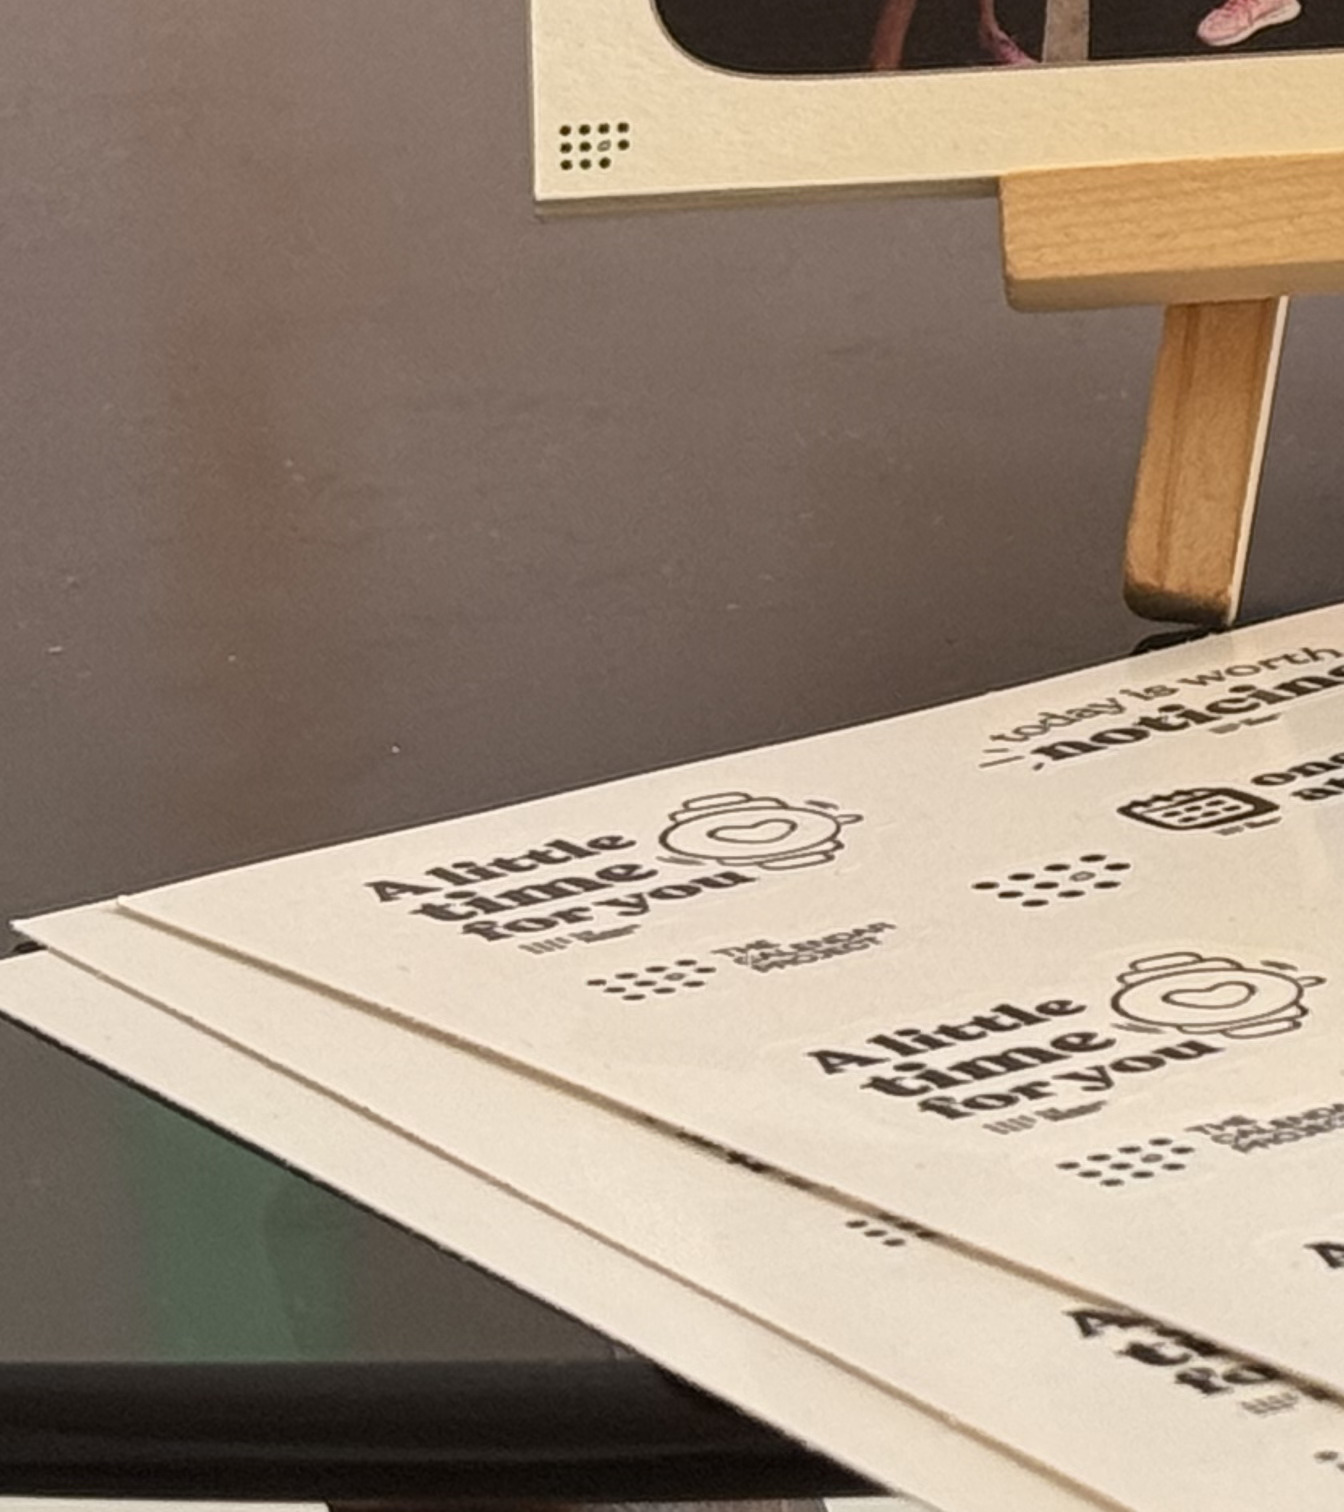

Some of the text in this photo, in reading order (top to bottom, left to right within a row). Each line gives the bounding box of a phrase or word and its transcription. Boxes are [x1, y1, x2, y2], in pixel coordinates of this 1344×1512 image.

[990, 646, 1343, 743] today is worth
[365, 834, 636, 902] A little
[409, 863, 658, 921] time
[461, 906, 593, 941] for
[594, 871, 760, 916] you
[806, 999, 1087, 1074] A little
[860, 1031, 1116, 1097] time
[918, 1081, 1056, 1119] for
[1053, 1040, 1225, 1091] you
[1174, 1364, 1283, 1395] fo
